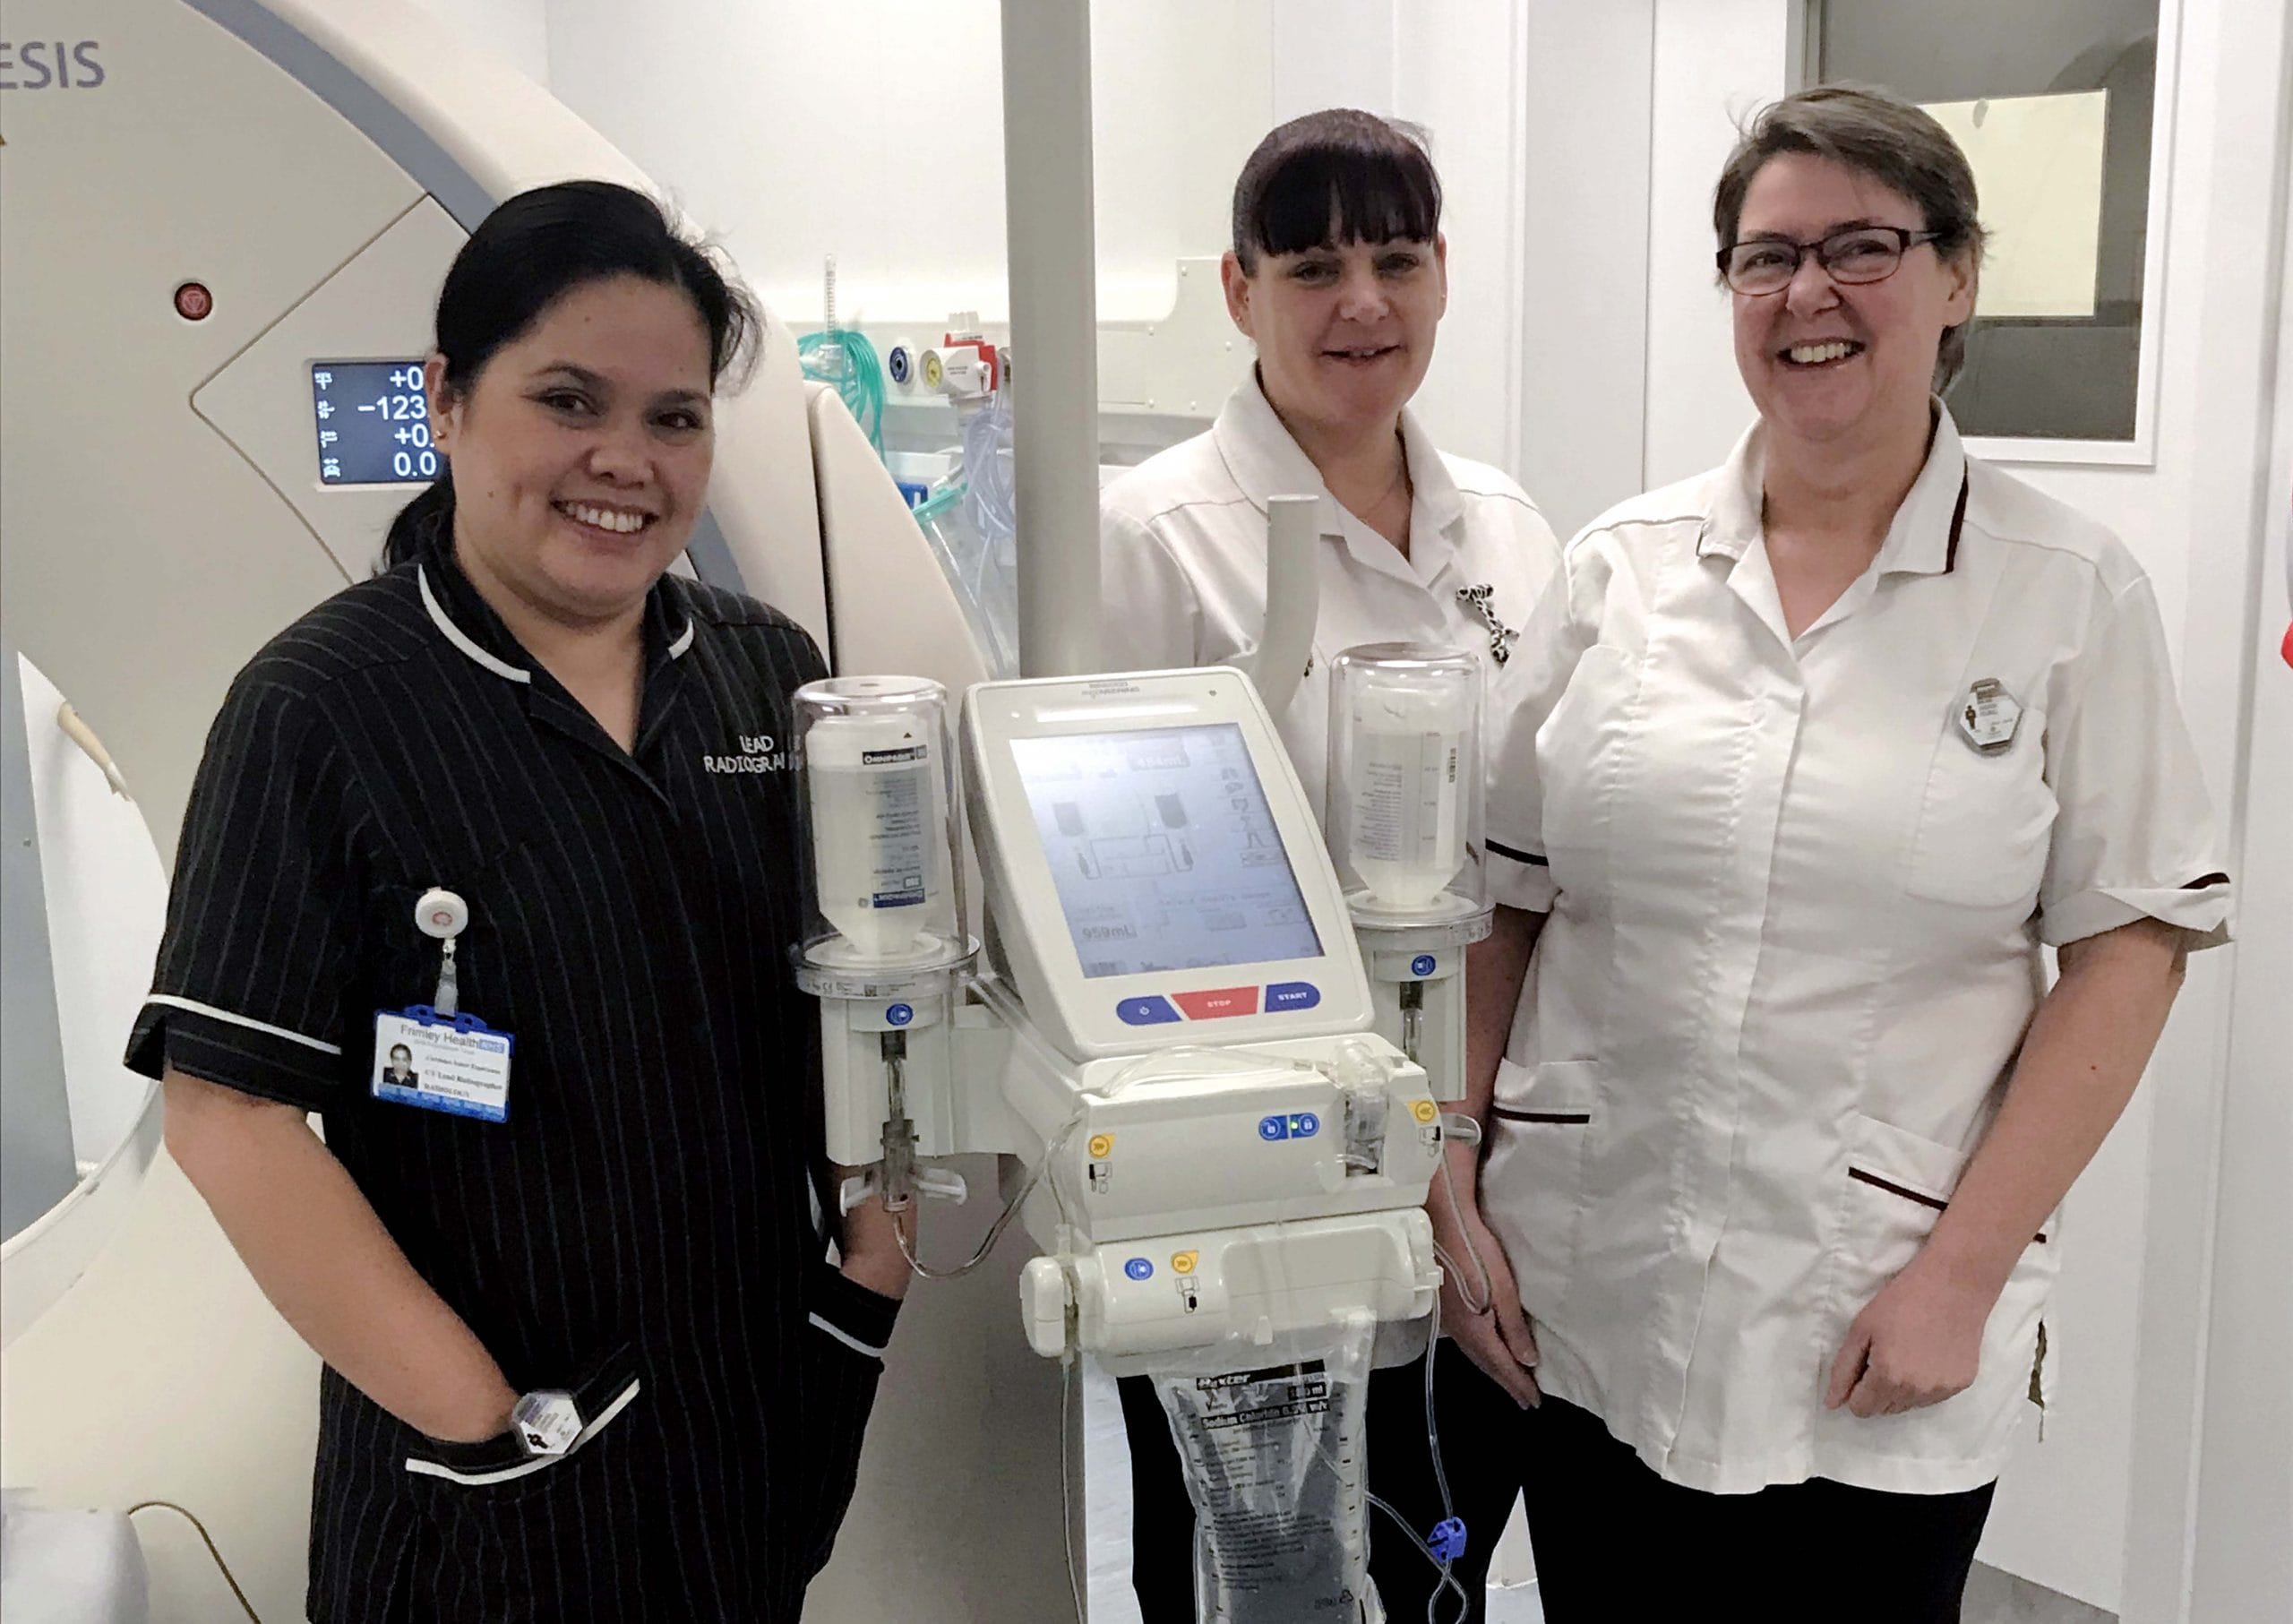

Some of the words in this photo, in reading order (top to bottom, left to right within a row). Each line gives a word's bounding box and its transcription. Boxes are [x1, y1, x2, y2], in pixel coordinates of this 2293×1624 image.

[393, 451, 437, 477] 0.0
[739, 735, 774, 753] LEAD
[1207, 999, 1232, 1008] STOP
[1277, 991, 1308, 1001] START
[400, 1024, 441, 1043] Frimley
[443, 1032, 478, 1048] Health
